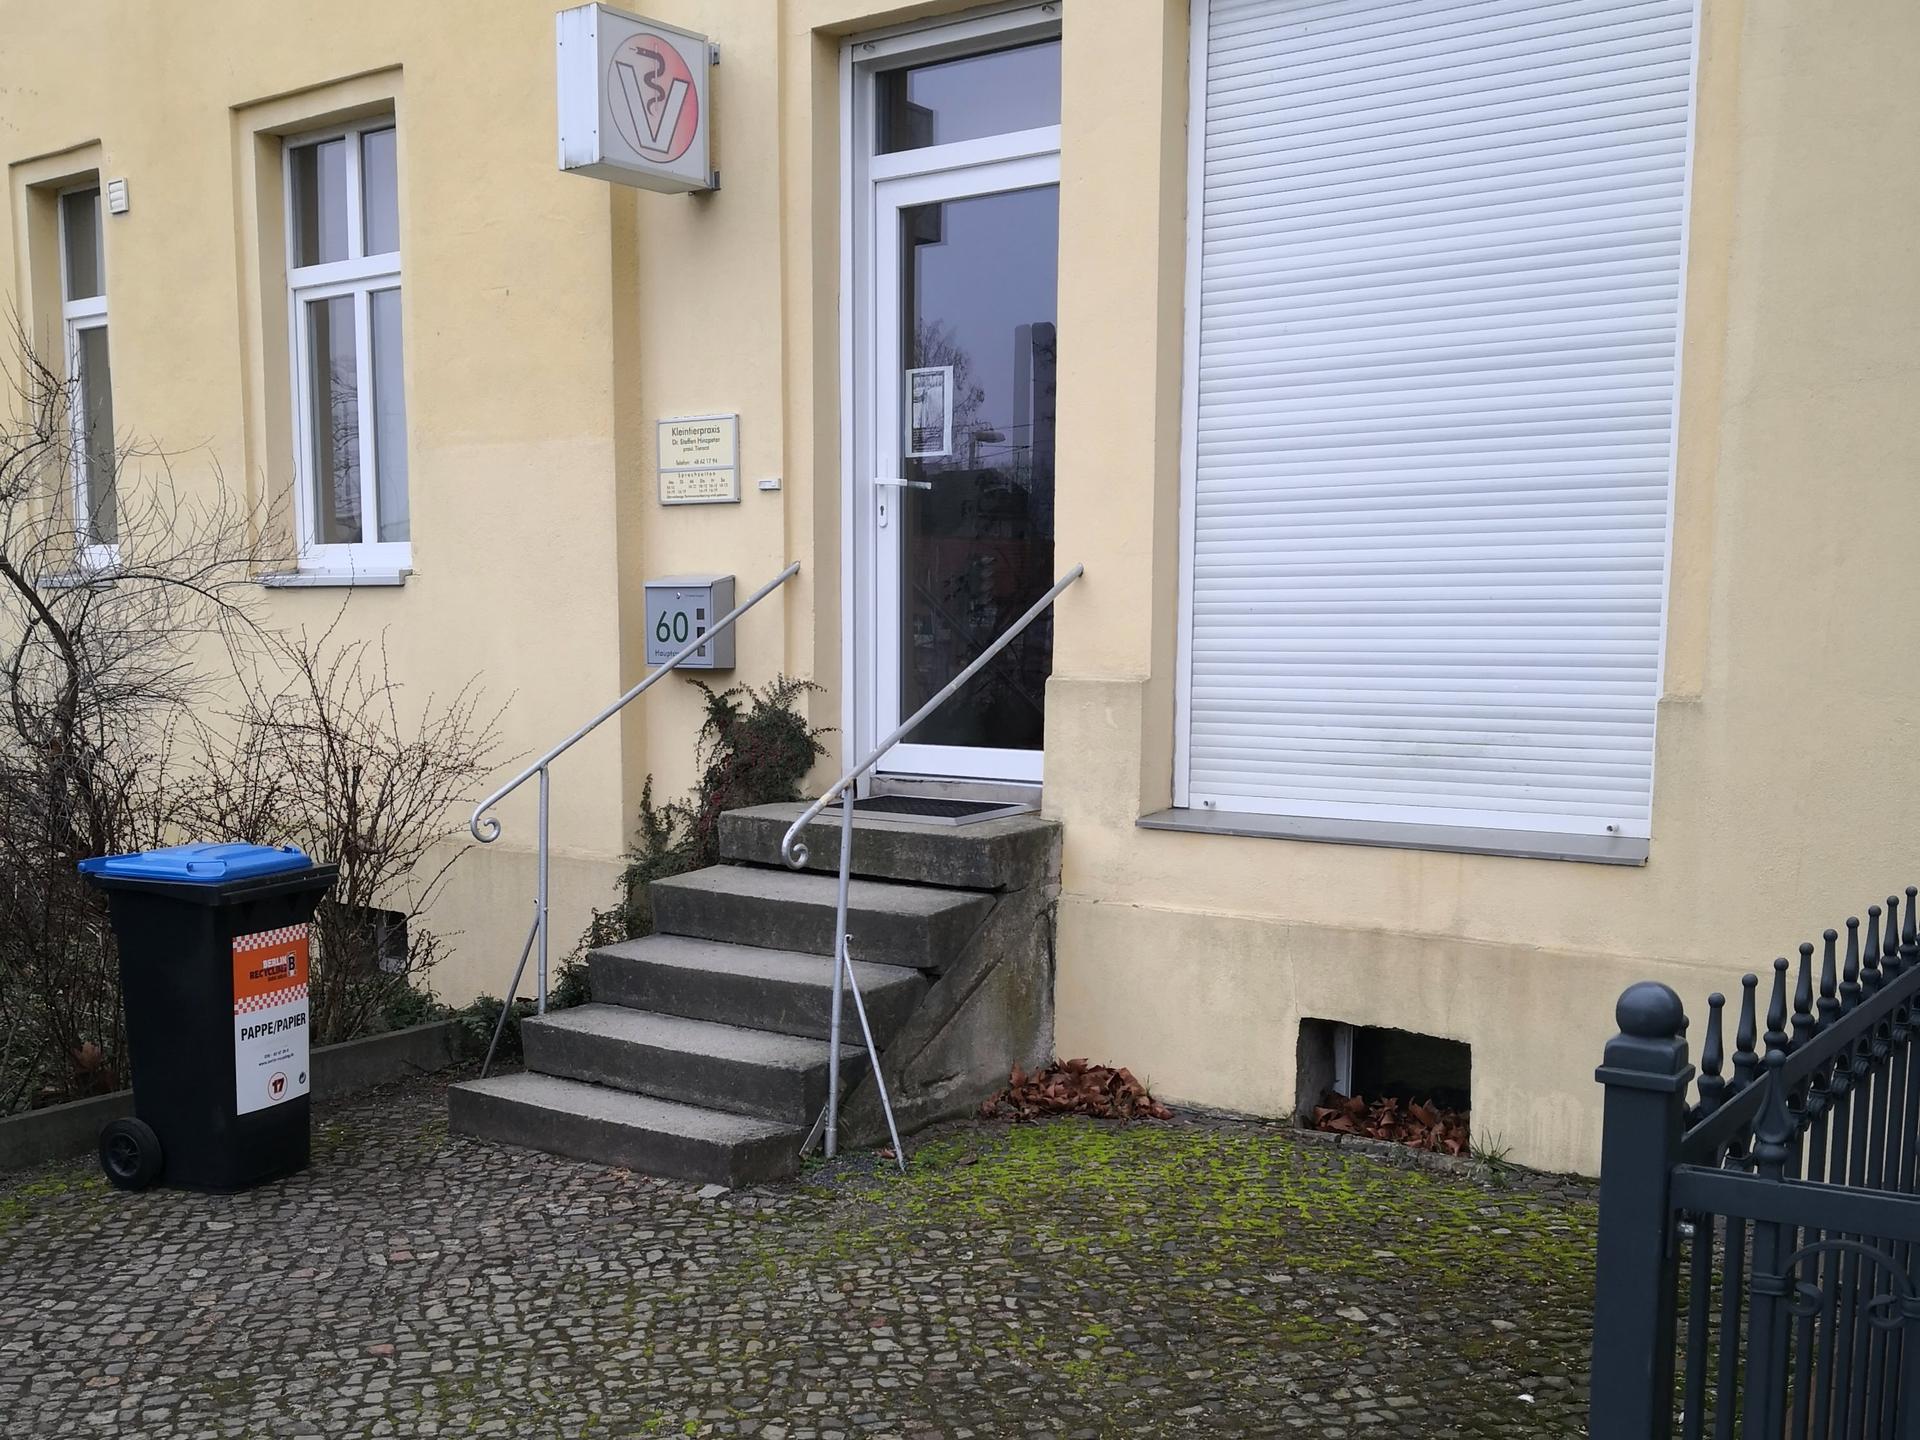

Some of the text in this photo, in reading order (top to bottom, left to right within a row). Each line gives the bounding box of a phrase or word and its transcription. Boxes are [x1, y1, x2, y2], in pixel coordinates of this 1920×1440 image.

[671, 425, 721, 437] Kleintierpraxis
[656, 610, 689, 643] 60
[263, 955, 287, 969] BERLIN
[249, 964, 287, 979] RECYCLING
[241, 1012, 306, 1041] PAPPE/PAPIER
[272, 1077, 285, 1094] 17
